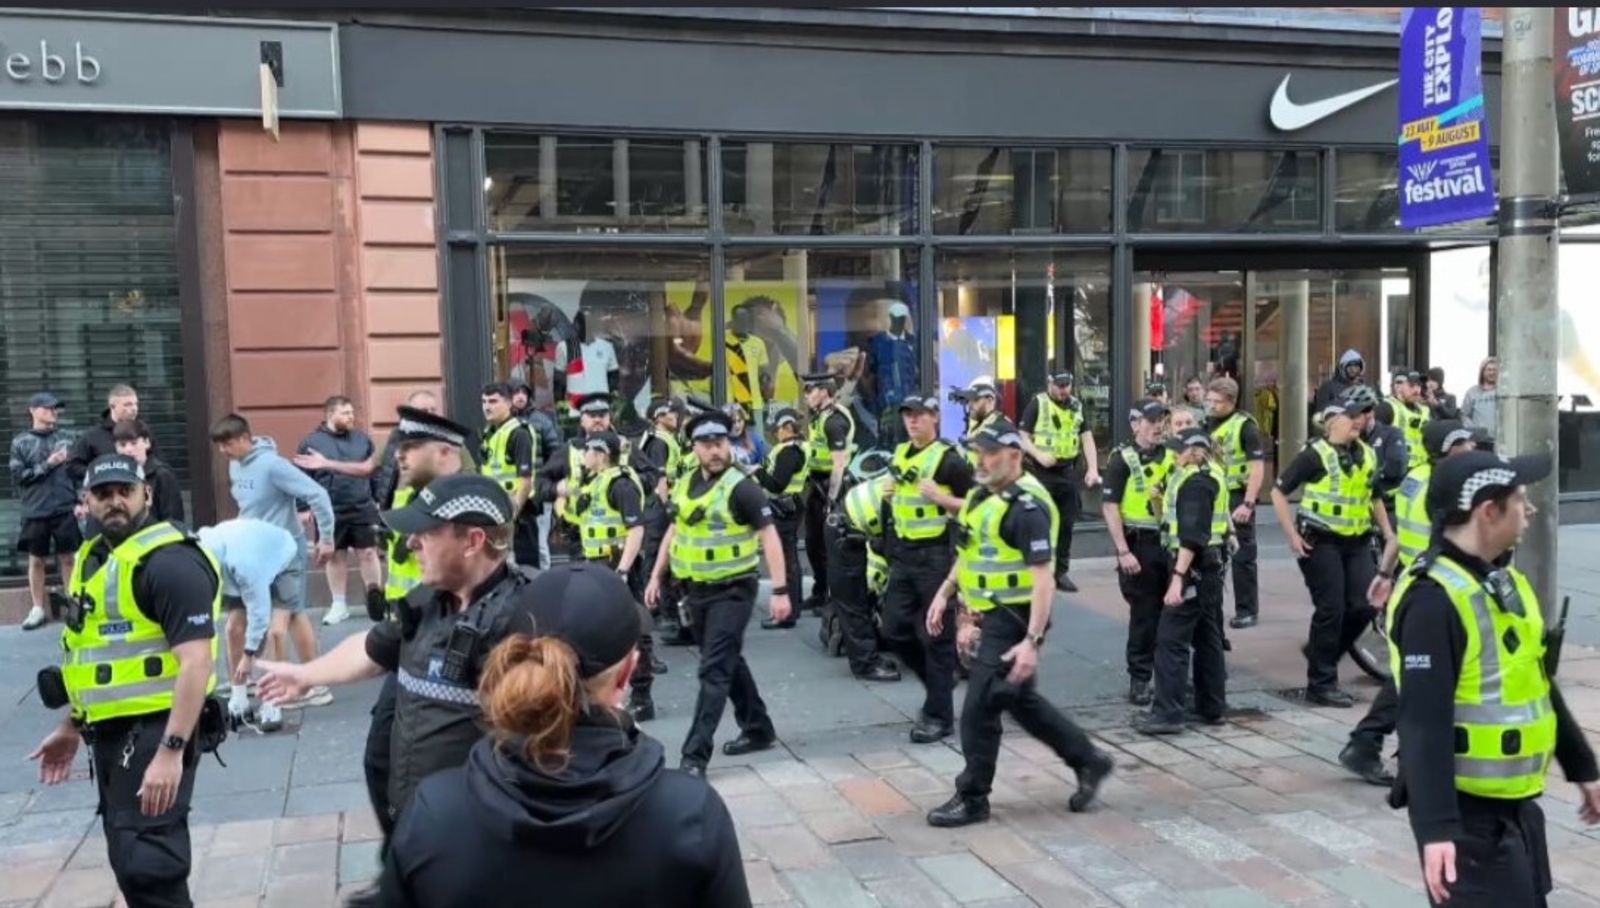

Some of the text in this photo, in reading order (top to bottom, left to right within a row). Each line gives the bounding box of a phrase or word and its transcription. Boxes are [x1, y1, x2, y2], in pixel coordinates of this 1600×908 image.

[6, 39, 100, 82] ebb
[1423, 25, 1436, 108] THE CITY
[1435, 7, 1453, 104] EXPLO
[1571, 87, 1600, 114] SC
[1417, 120, 1435, 133] MAY
[1428, 134, 1435, 147] 9
[1436, 124, 1476, 146] AUGUST
[1405, 165, 1485, 205] festival
[94, 461, 129, 474] POLICE
